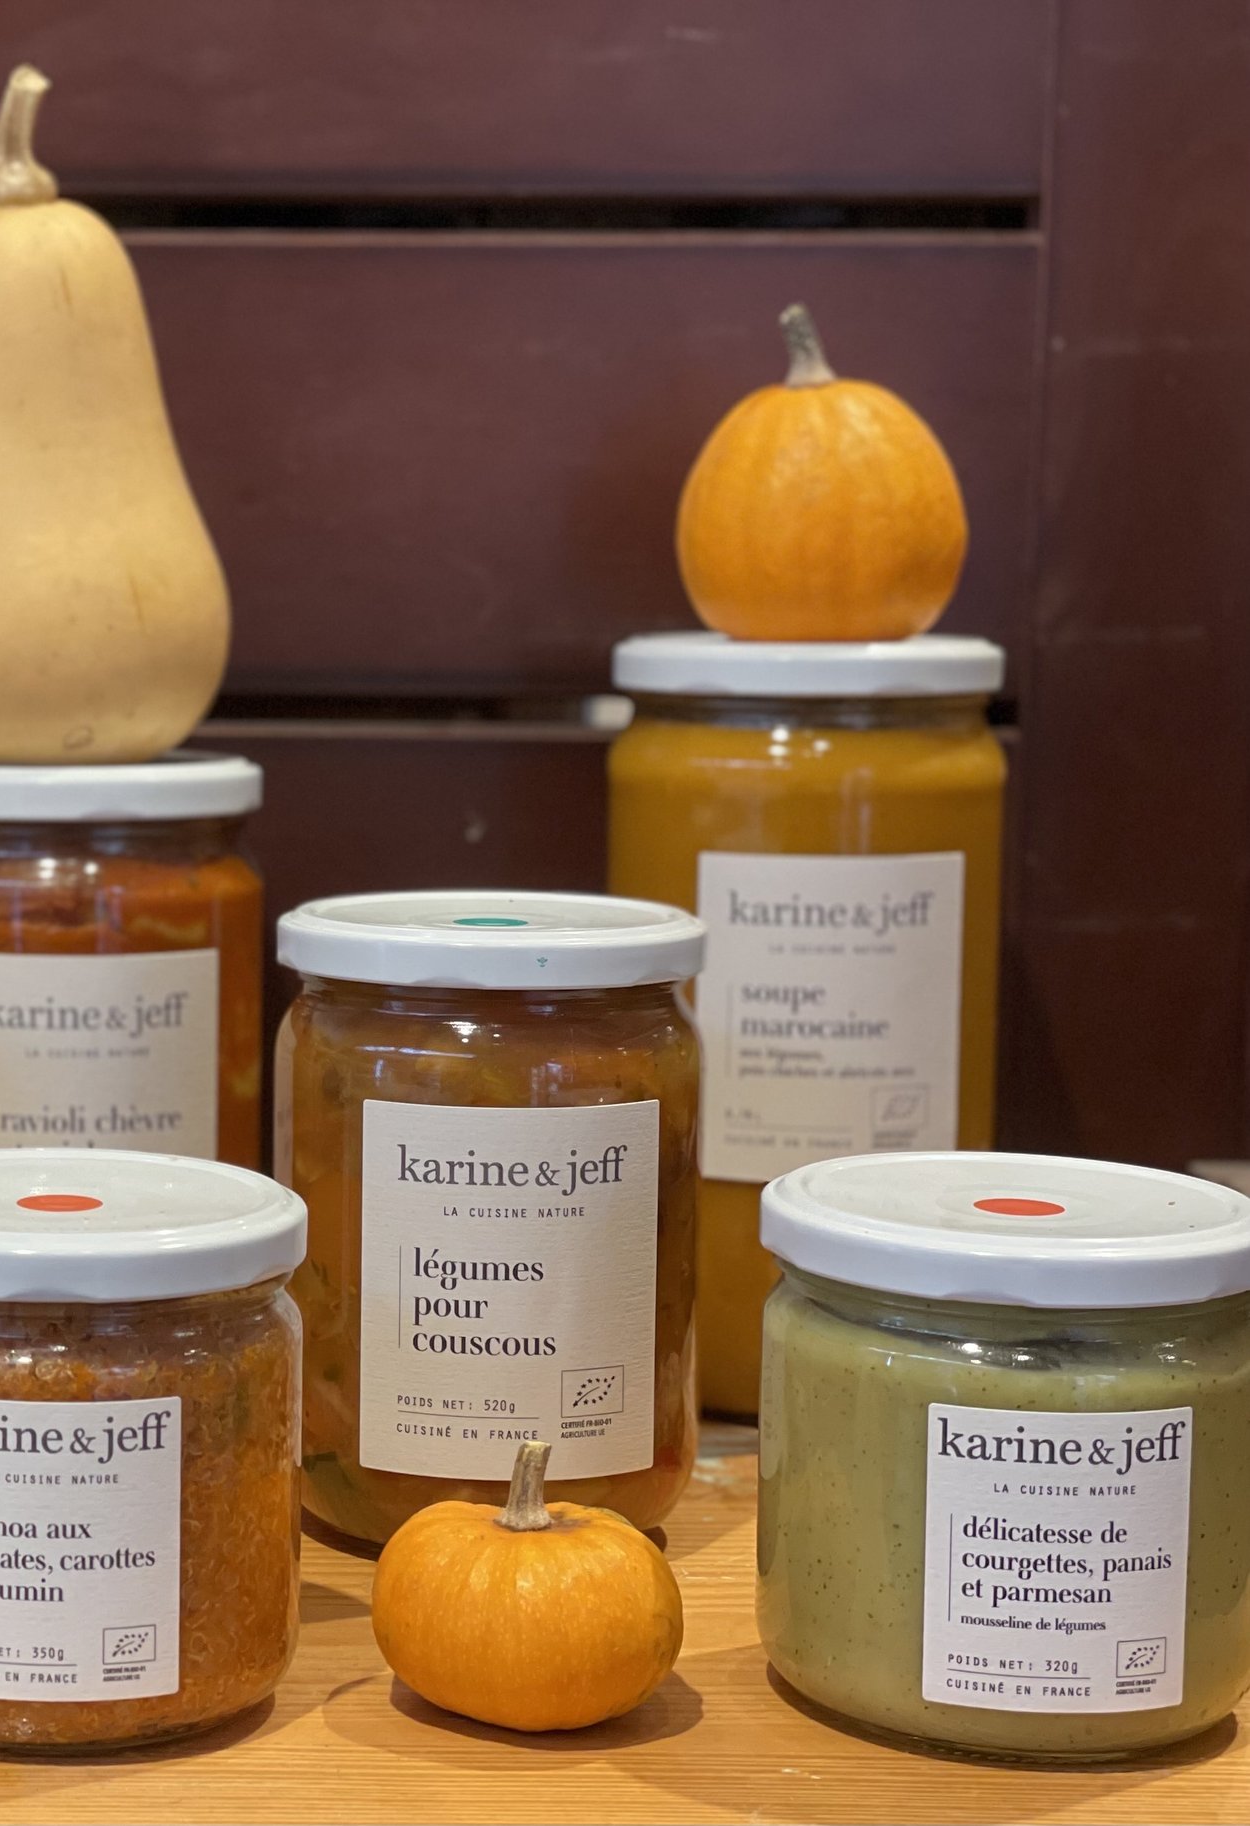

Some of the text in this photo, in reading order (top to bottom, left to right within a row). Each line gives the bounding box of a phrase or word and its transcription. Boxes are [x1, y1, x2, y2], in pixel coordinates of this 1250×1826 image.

[727, 890, 936, 938] karine & jeff
[740, 983, 825, 1013] soupe
[104, 1006, 128, 1031] &
[128, 990, 189, 1038] jeff
[740, 1011, 890, 1039] marocaine
[0, 1104, 182, 1134] ravioli chèvre
[396, 1144, 628, 1196] karine & jeff
[443, 1206, 585, 1219] LA CUISINE NATURE
[413, 1247, 544, 1291] légumes
[413, 1295, 489, 1326] pour
[412, 1332, 557, 1357] couscous
[396, 1394, 515, 1414] POIDS NET: 520g
[69, 1427, 96, 1454] &
[97, 1410, 172, 1464] jeff
[396, 1423, 539, 1440] CUISINÉ EN FRANCE
[937, 1417, 1186, 1476] karine & jeff
[5, 1473, 61, 1485] CUISINE
[71, 1473, 119, 1485] NATURE
[993, 1483, 1137, 1496] LA CUISINE NATURE
[46, 1522, 93, 1539] aux
[962, 1515, 1128, 1544] délicatesse de
[59, 1547, 156, 1571] carottes
[962, 1547, 1172, 1582] courgettes, panais
[961, 1578, 1112, 1608] et parmesan
[960, 1615, 1107, 1635] mousseline de légumes
[31, 1647, 65, 1662] 350g
[947, 1653, 1078, 1675] POIDS NET: 320g
[5, 1671, 20, 1682] EN
[30, 1673, 78, 1684] FRANCE
[946, 1677, 1091, 1697] CUISINÉ EN FRANCE
